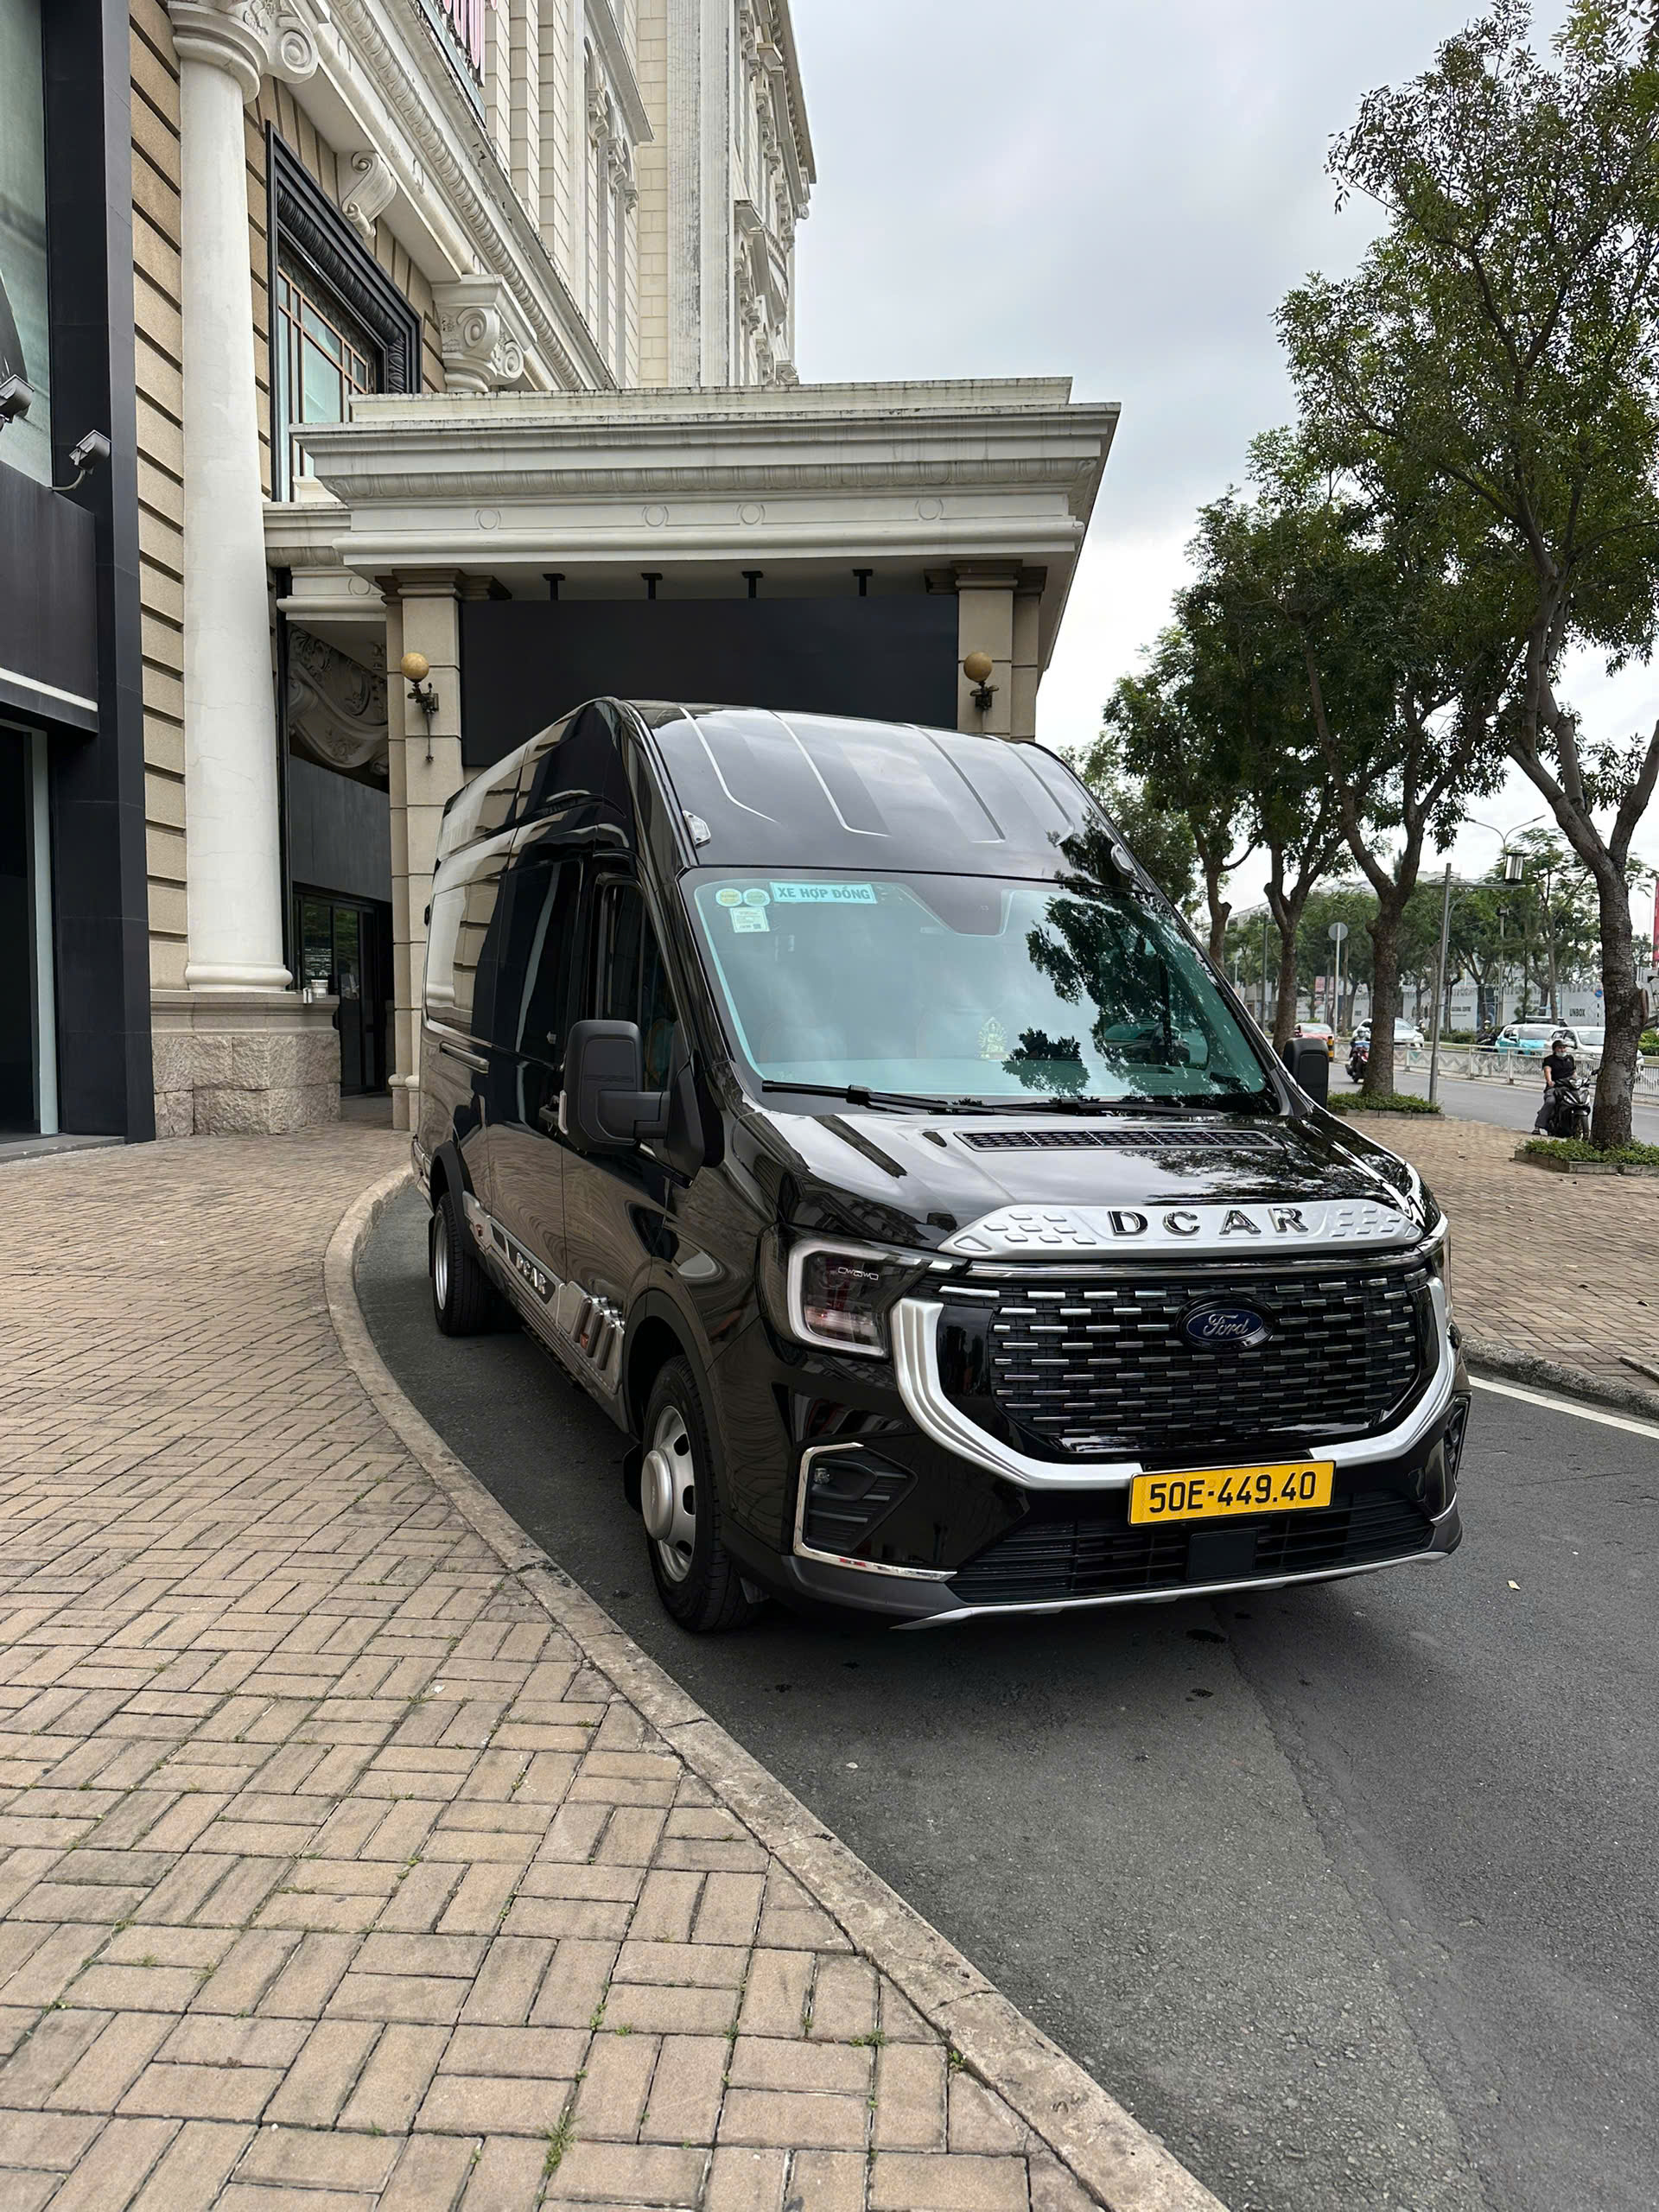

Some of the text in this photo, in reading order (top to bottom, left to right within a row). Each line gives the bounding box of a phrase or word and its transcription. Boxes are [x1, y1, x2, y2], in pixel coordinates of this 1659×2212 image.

[778, 887, 796, 898] XE
[800, 887, 828, 899] HỢP
[1108, 1208, 1309, 1236] DCAR
[1203, 1313, 1249, 1337] Ford
[1149, 1471, 1316, 1514] 50E-449.40
